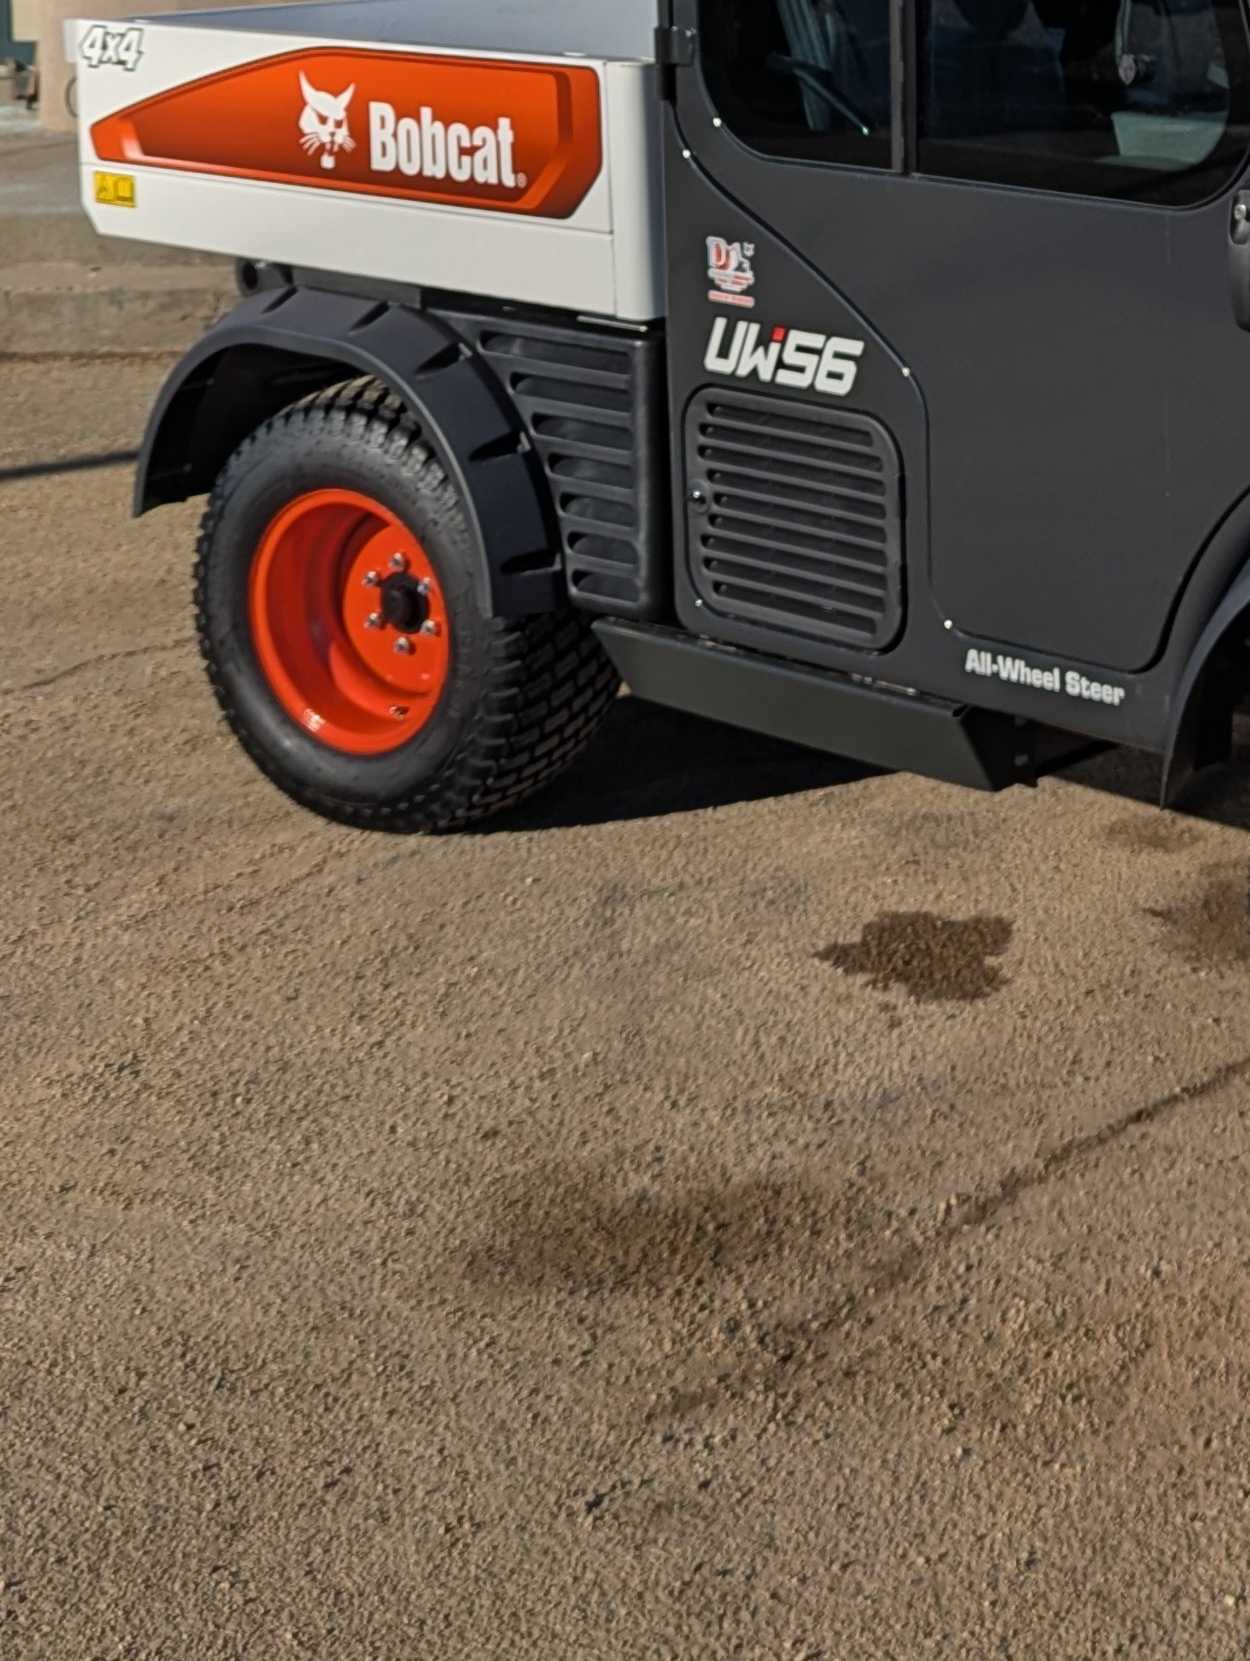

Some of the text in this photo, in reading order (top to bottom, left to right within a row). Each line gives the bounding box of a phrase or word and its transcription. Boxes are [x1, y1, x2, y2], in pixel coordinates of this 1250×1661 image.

[80, 26, 144, 70] 4x4
[369, 101, 515, 188] Bobcat
[964, 648, 1126, 707] All-Wheel Steer
